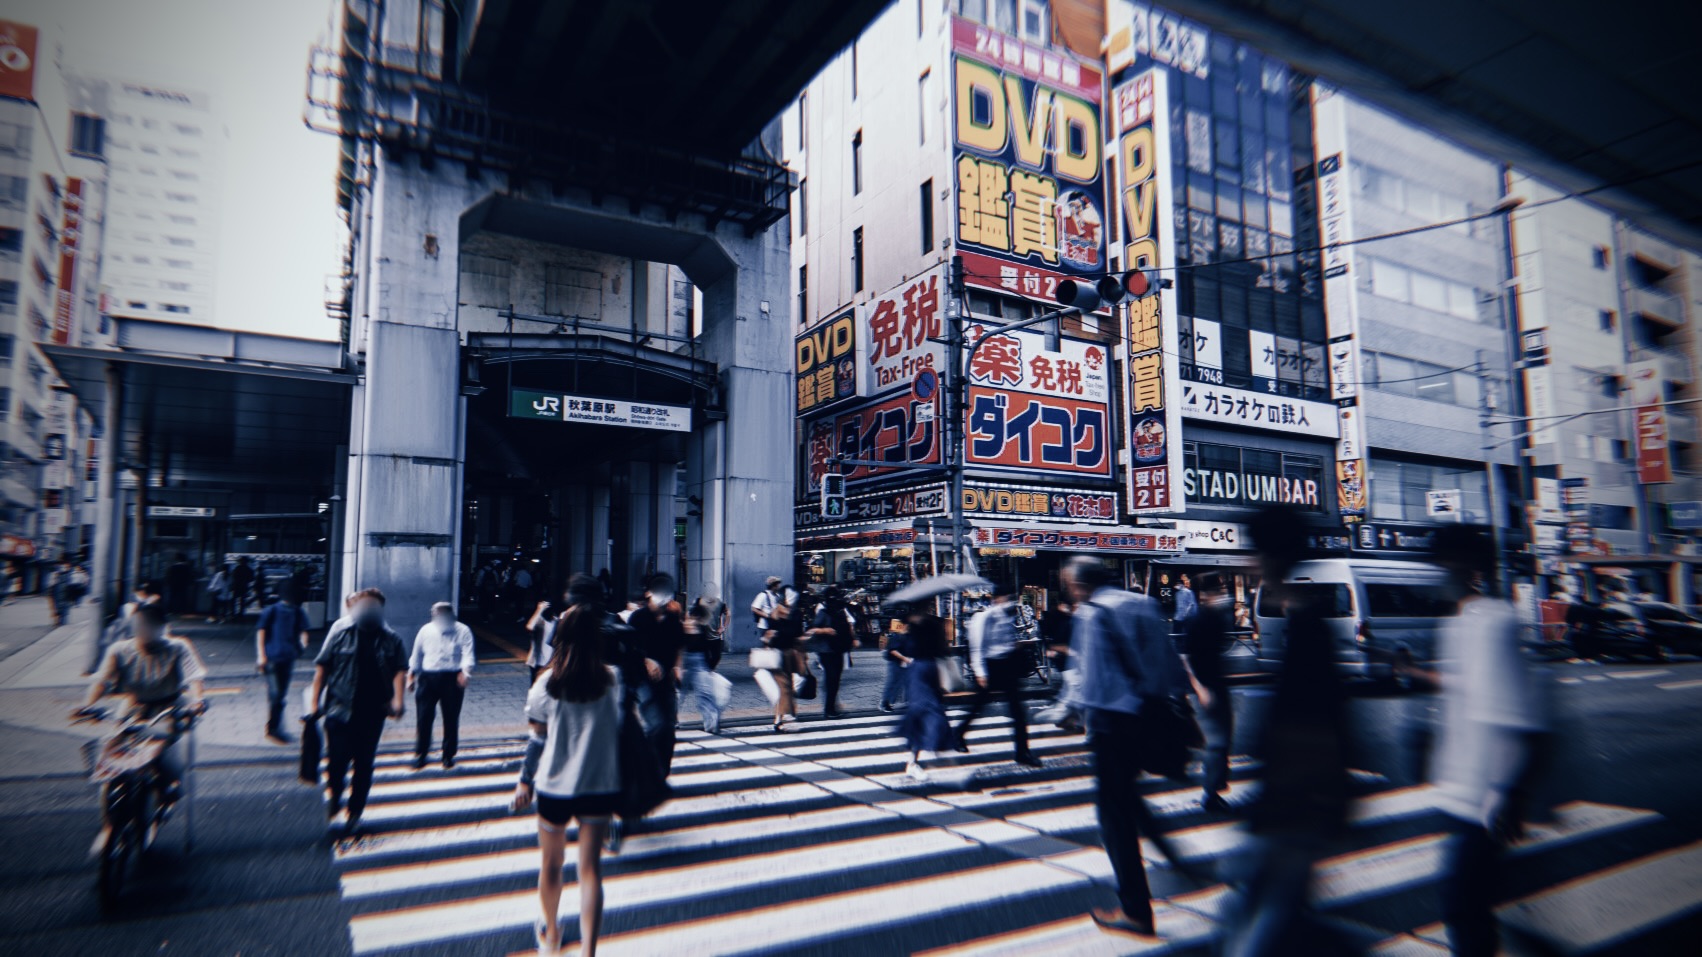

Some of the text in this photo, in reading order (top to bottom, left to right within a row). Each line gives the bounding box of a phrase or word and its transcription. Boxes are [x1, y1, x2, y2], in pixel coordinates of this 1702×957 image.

[954, 57, 1101, 184] DVD
[957, 153, 1059, 265] 鑑賞
[1001, 265, 1057, 298] 受付2
[1120, 127, 1164, 412] DVD鑑賞
[869, 274, 940, 365] 免税
[797, 317, 853, 374] DVD
[971, 324, 1023, 384] 薬
[1263, 346, 1314, 373] カラオケ
[797, 363, 835, 411] 鑑賞
[875, 353, 933, 387] Tax-Free
[1029, 355, 1083, 395] 免税
[1197, 367, 1223, 384] 7948
[533, 397, 559, 411] JR
[568, 411, 603, 421] Akihabara
[604, 415, 627, 424] Station
[569, 400, 616, 414] 秋葉原駅
[1204, 391, 1310, 427] カラオケの鉄人
[838, 397, 936, 478] ダイコク
[970, 393, 1106, 468] ダイコク
[1136, 469, 1165, 487] 受付
[1137, 489, 1165, 506] 2F
[1210, 528, 1235, 543] C&C
